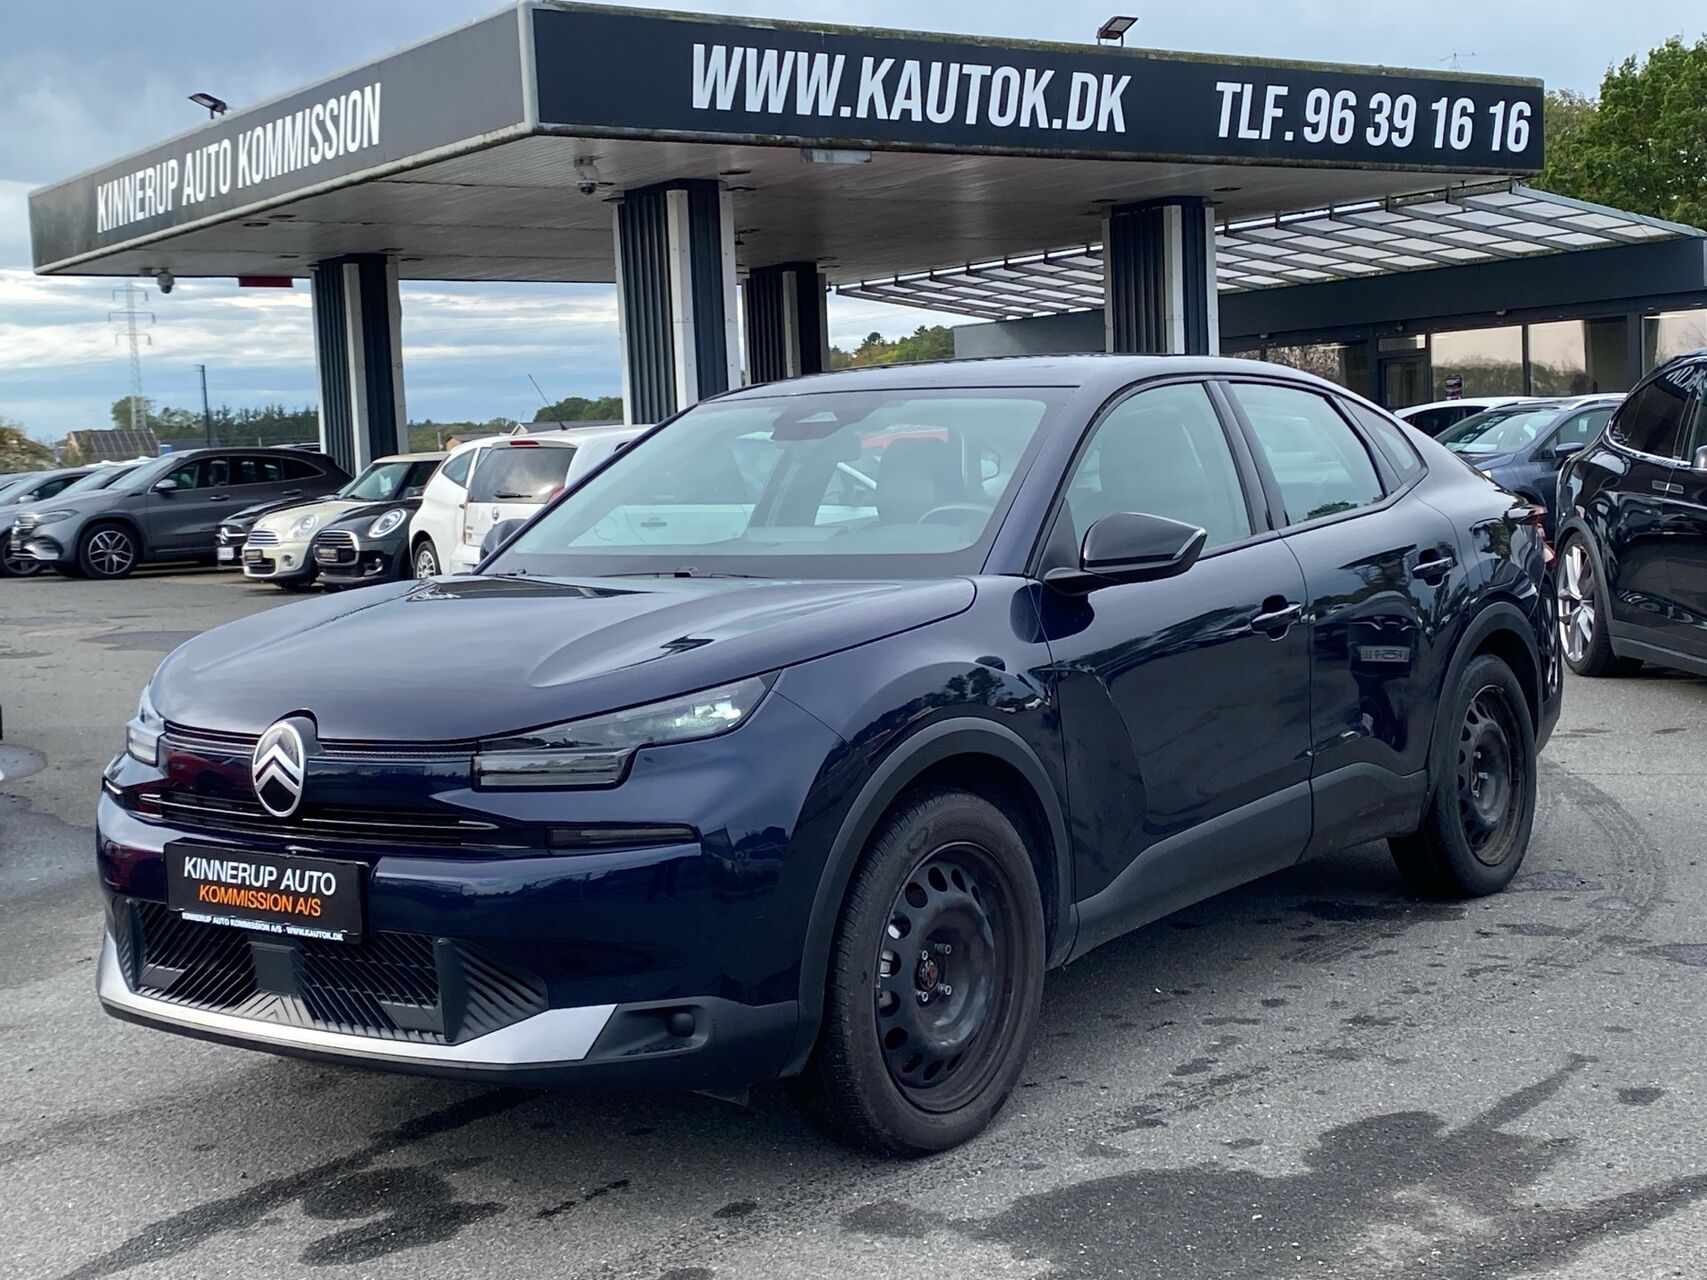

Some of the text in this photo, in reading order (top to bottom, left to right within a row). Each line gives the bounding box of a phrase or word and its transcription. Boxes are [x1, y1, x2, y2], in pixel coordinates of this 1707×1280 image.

[692, 43, 1132, 133] WWW.KAUTOK.DK
[1215, 81, 1532, 153] TLF. 96 39 16 16
[97, 82, 382, 234] KINNERUP AUTO KOMMISSION
[183, 856, 337, 896] KINNERUP AUTO
[199, 884, 322, 917] KOMMISSION A/S
[212, 916, 230, 926] AUTO
[286, 926, 344, 941] WWW.KAUTOK.DK
